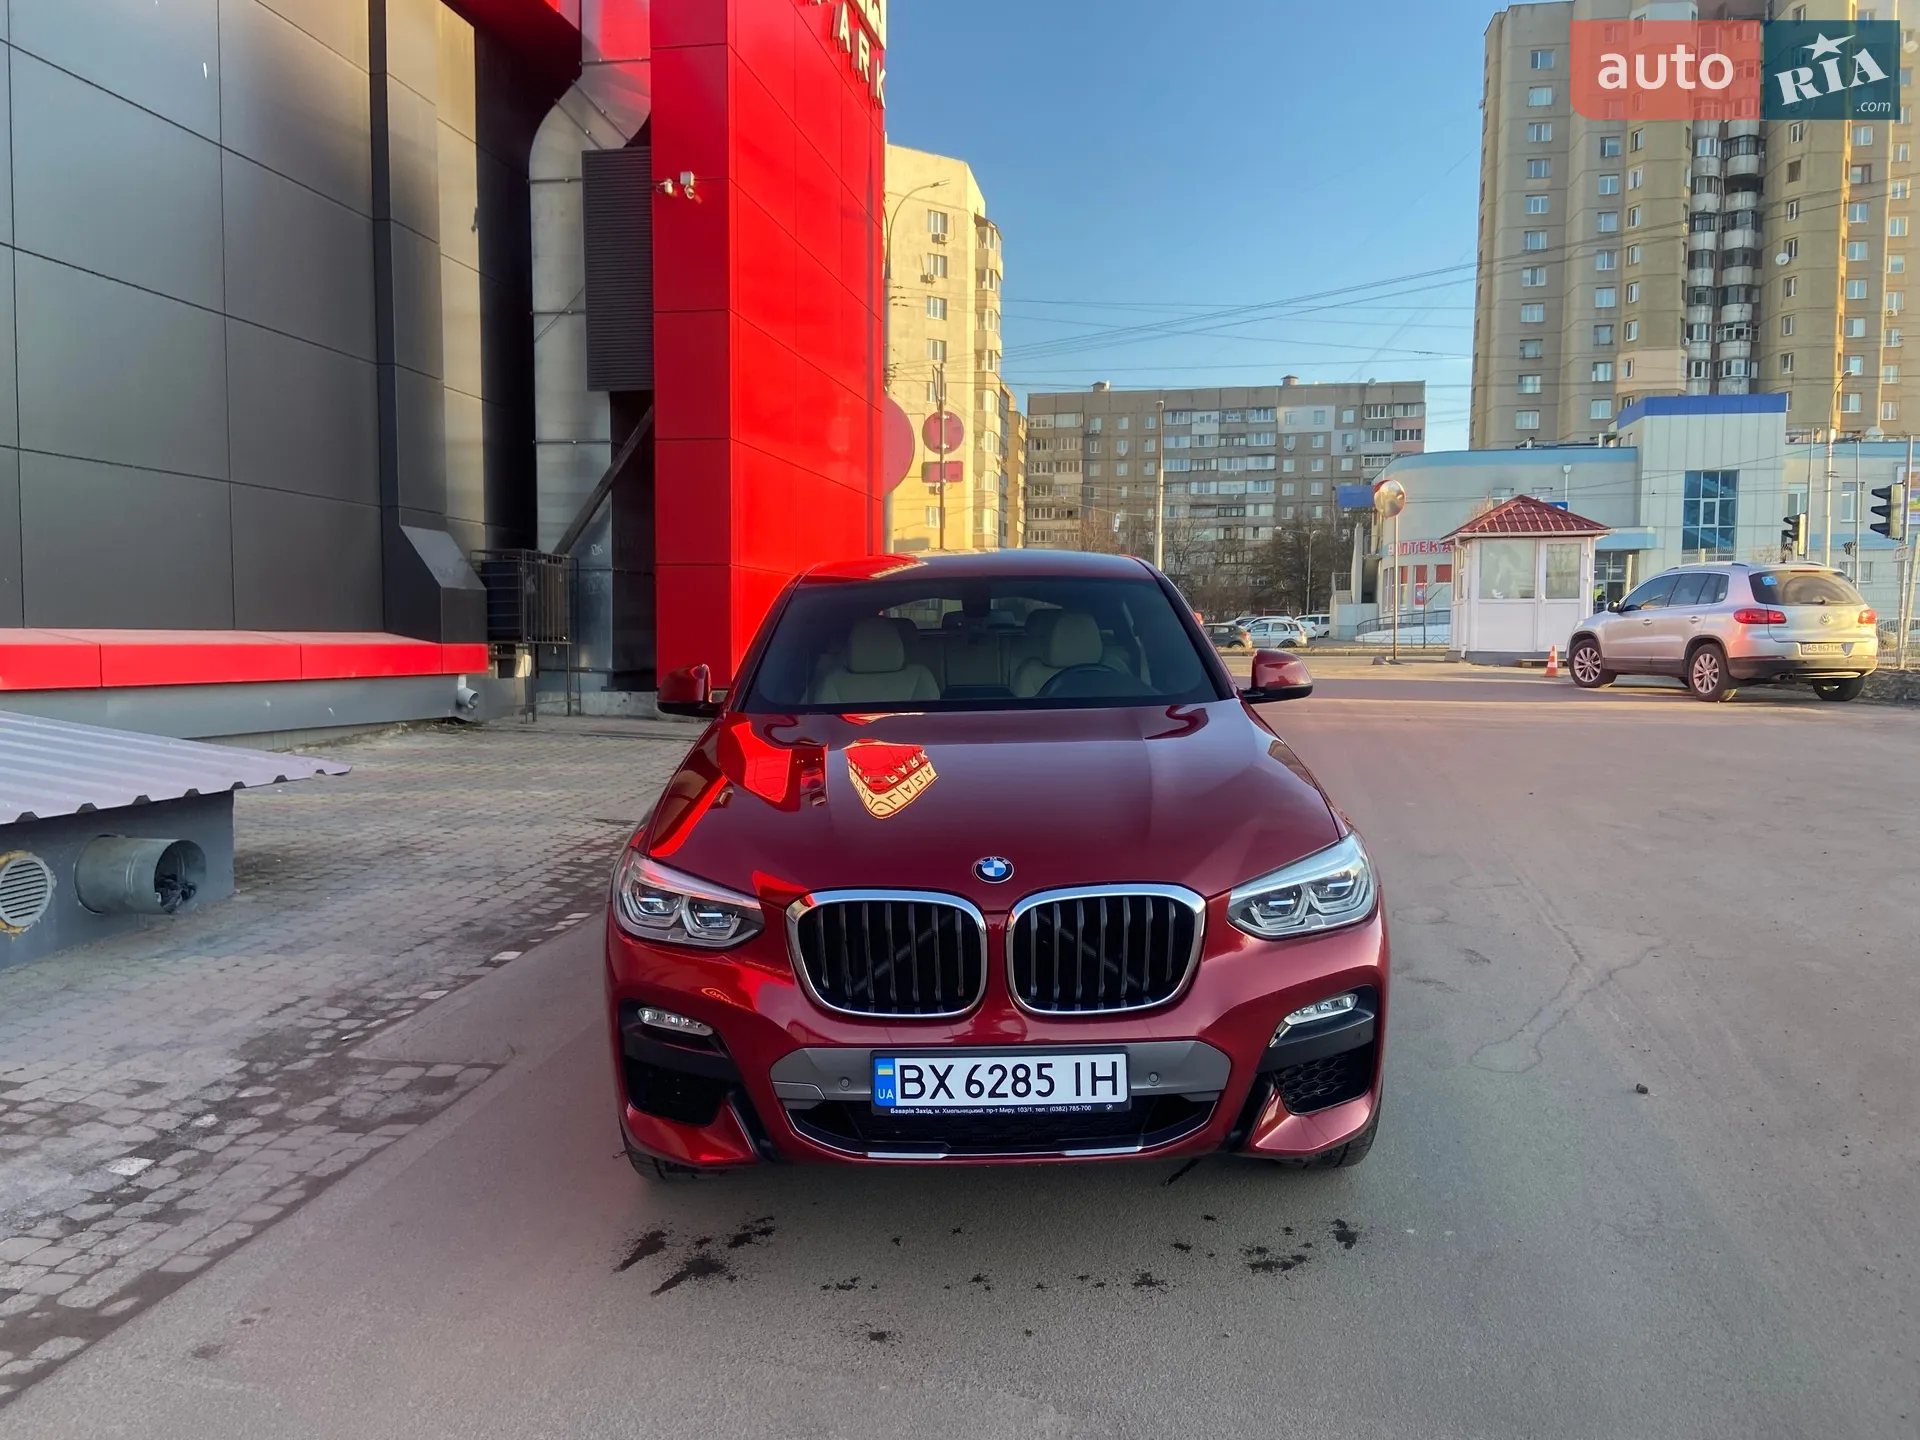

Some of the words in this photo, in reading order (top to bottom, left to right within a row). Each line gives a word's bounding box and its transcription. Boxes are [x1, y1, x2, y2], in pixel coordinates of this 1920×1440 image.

[900, 1064, 956, 1100] BX
[964, 1063, 1055, 1099] 6285
[1074, 1061, 1118, 1097] IH
[878, 1088, 894, 1100] UA
